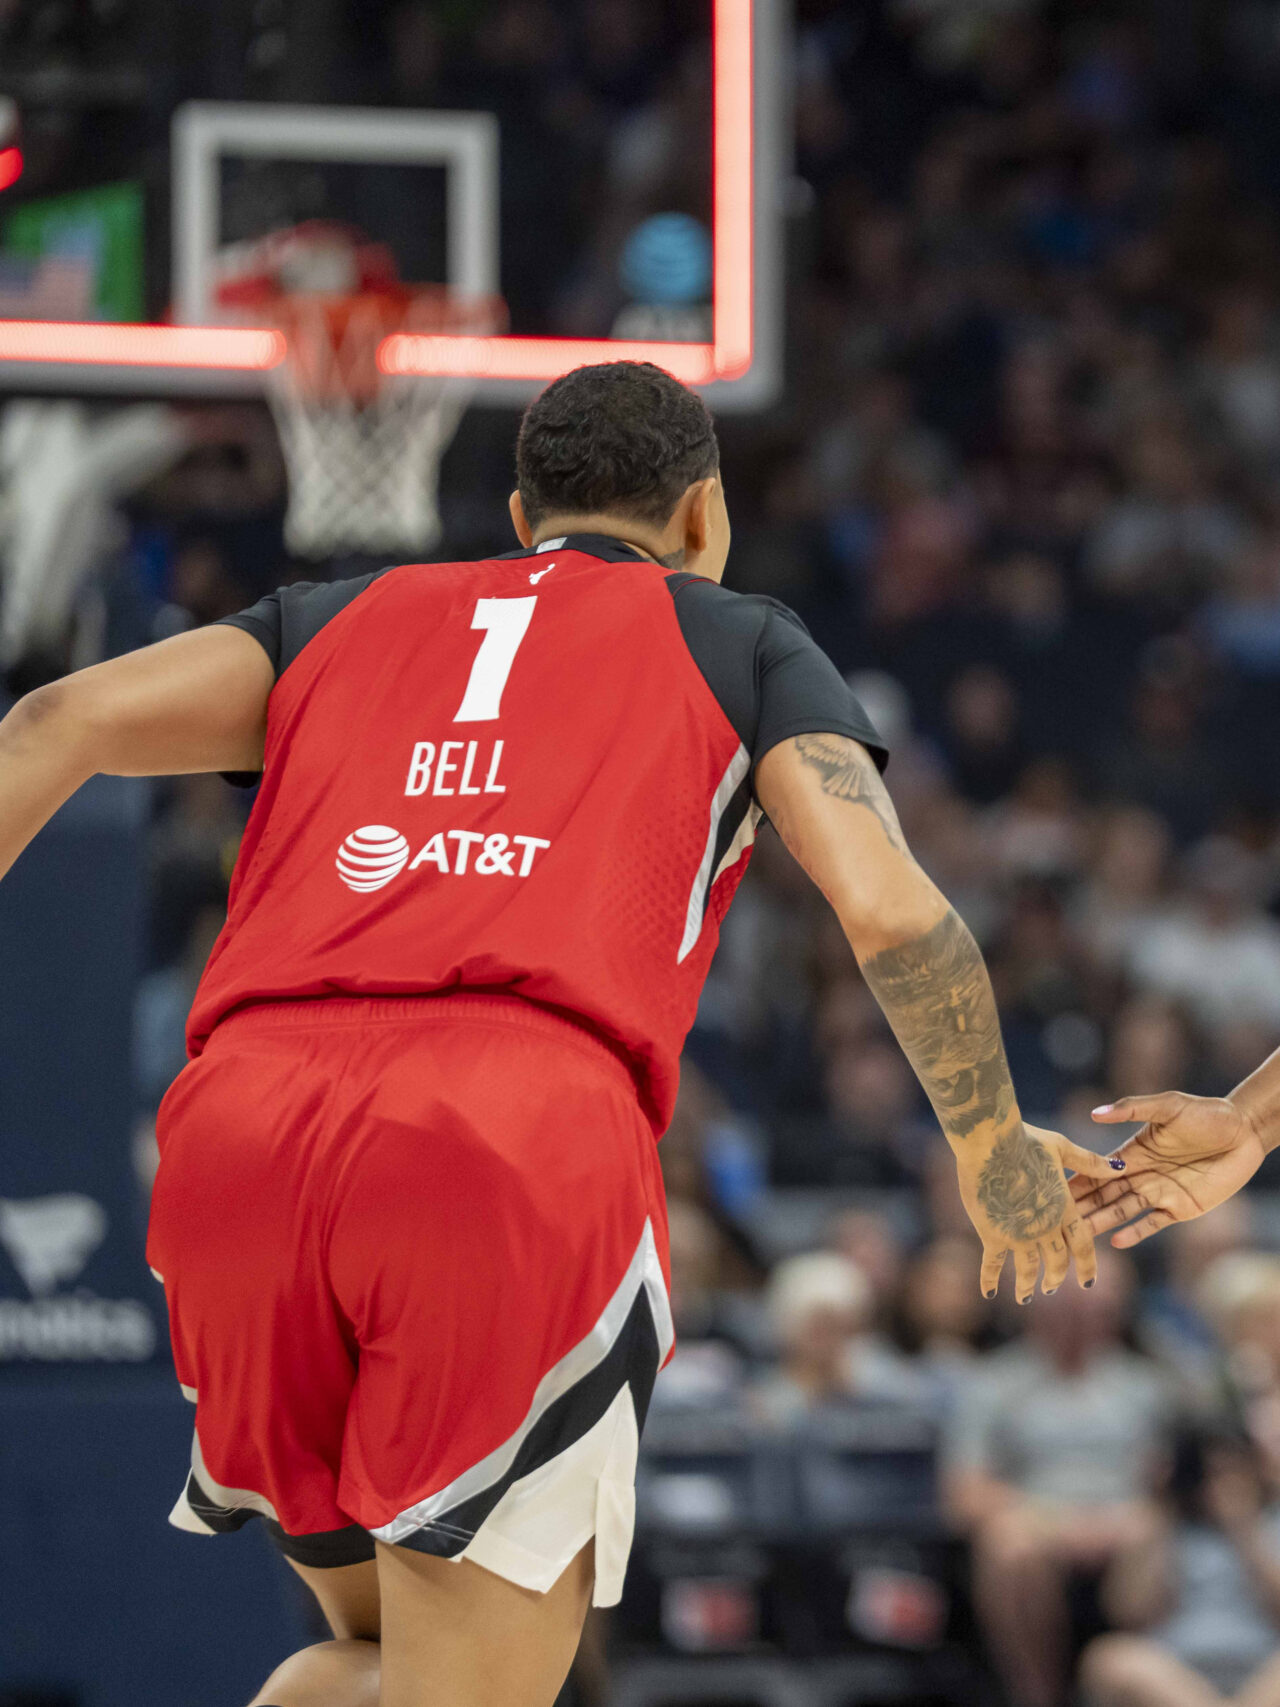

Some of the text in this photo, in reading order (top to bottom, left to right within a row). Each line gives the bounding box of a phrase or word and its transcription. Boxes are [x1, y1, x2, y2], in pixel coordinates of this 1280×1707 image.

[452, 595, 538, 723] 1
[404, 739, 507, 797] BELL
[407, 829, 551, 878] AT&T
